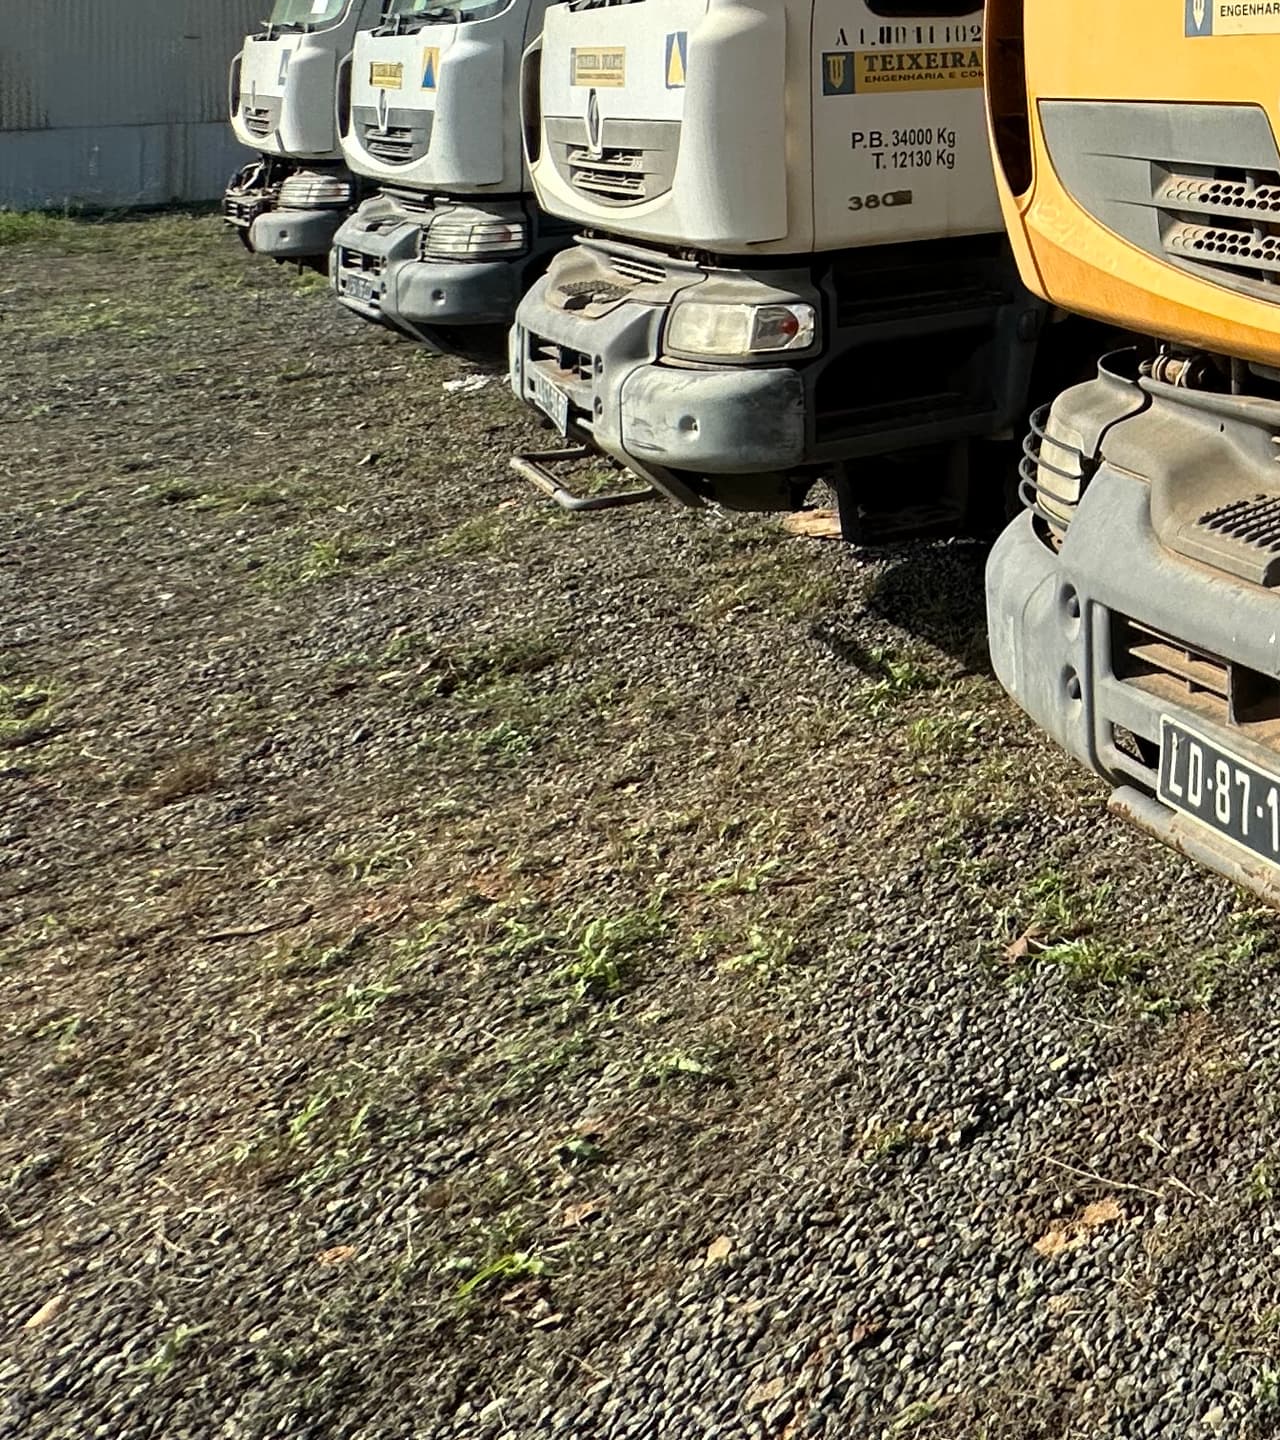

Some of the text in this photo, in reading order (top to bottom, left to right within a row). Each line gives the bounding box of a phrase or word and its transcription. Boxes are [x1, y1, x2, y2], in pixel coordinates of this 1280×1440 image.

[864, 51, 981, 72] TEIXEIRA
[864, 73, 944, 83] ENGENHARIA
[949, 71, 956, 79] E
[852, 127, 956, 149] P.B. 34000 Kg
[872, 149, 955, 169] T. 12130 Kg
